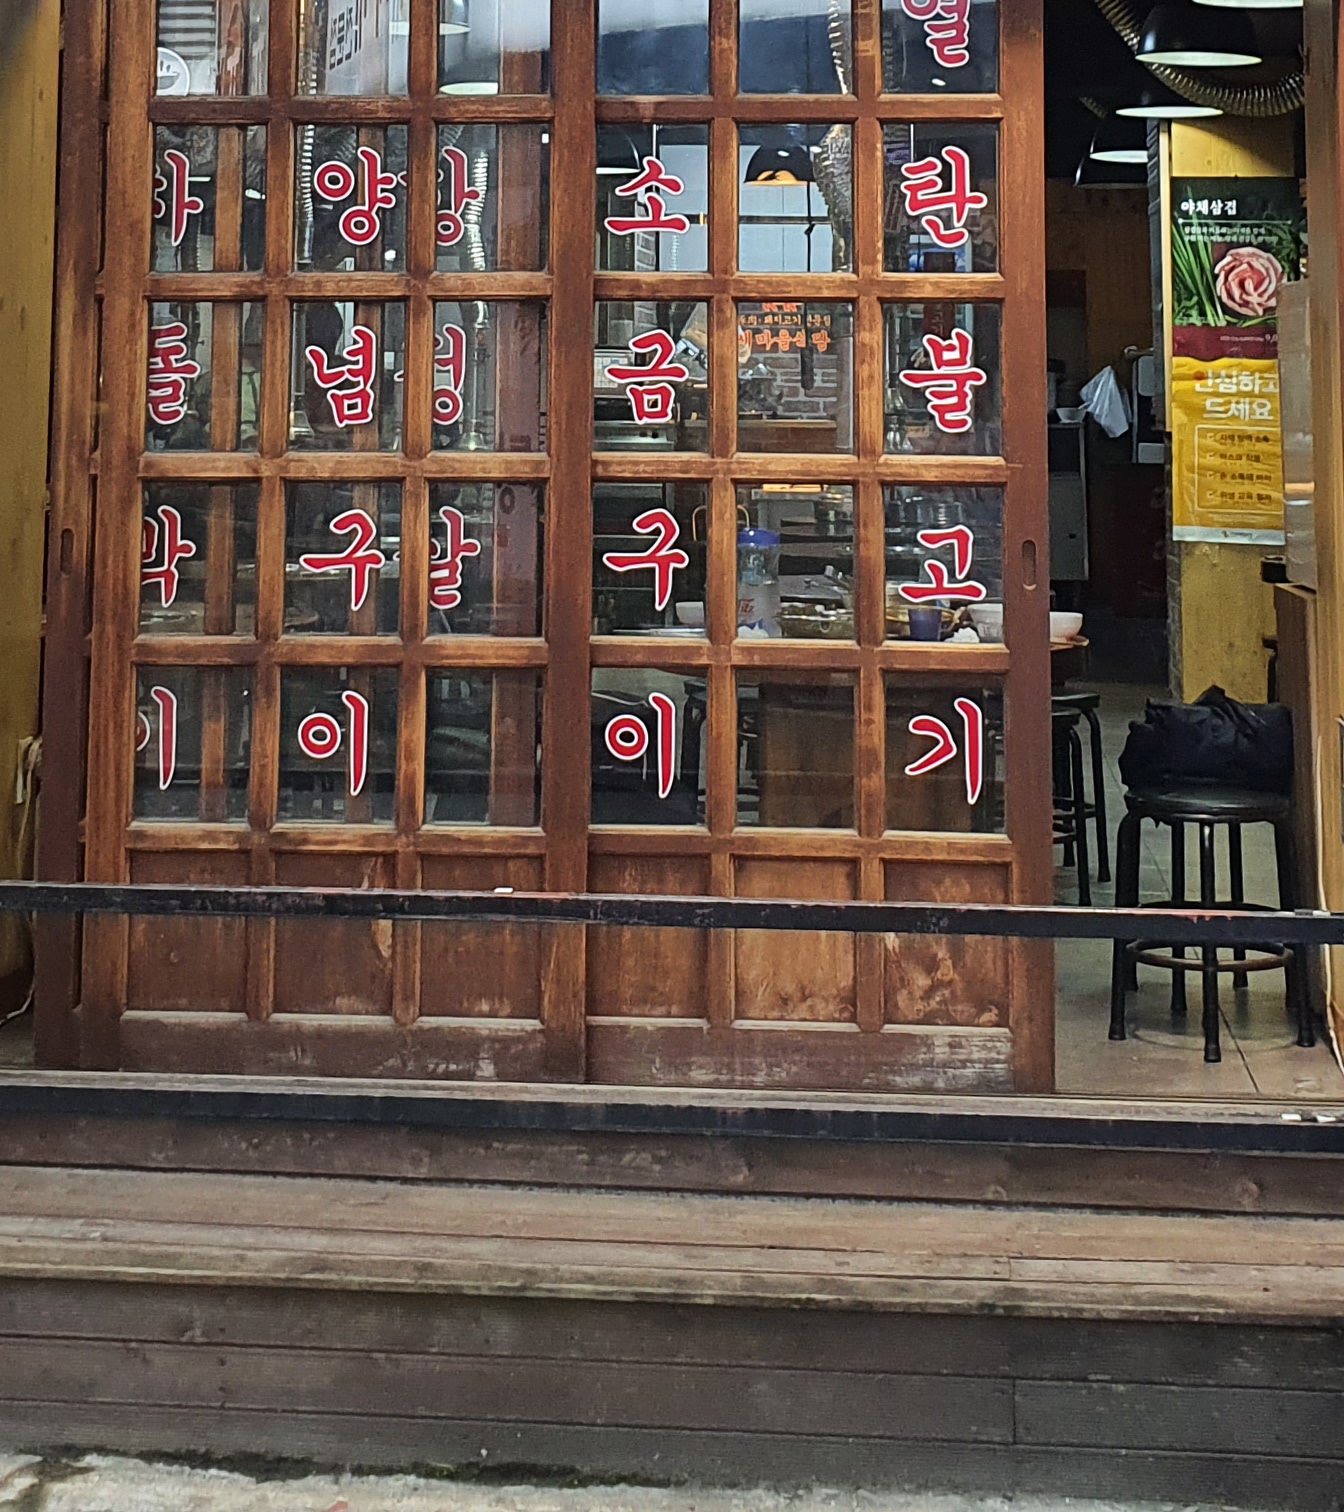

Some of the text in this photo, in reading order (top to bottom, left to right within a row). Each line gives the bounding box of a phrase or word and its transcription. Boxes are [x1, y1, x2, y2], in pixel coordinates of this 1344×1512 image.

[1181, 199, 1237, 215] 야채삼겹
[298, 147, 398, 797] 양념구이
[604, 156, 691, 799] 소금구이
[1203, 398, 1274, 420] 드세요
